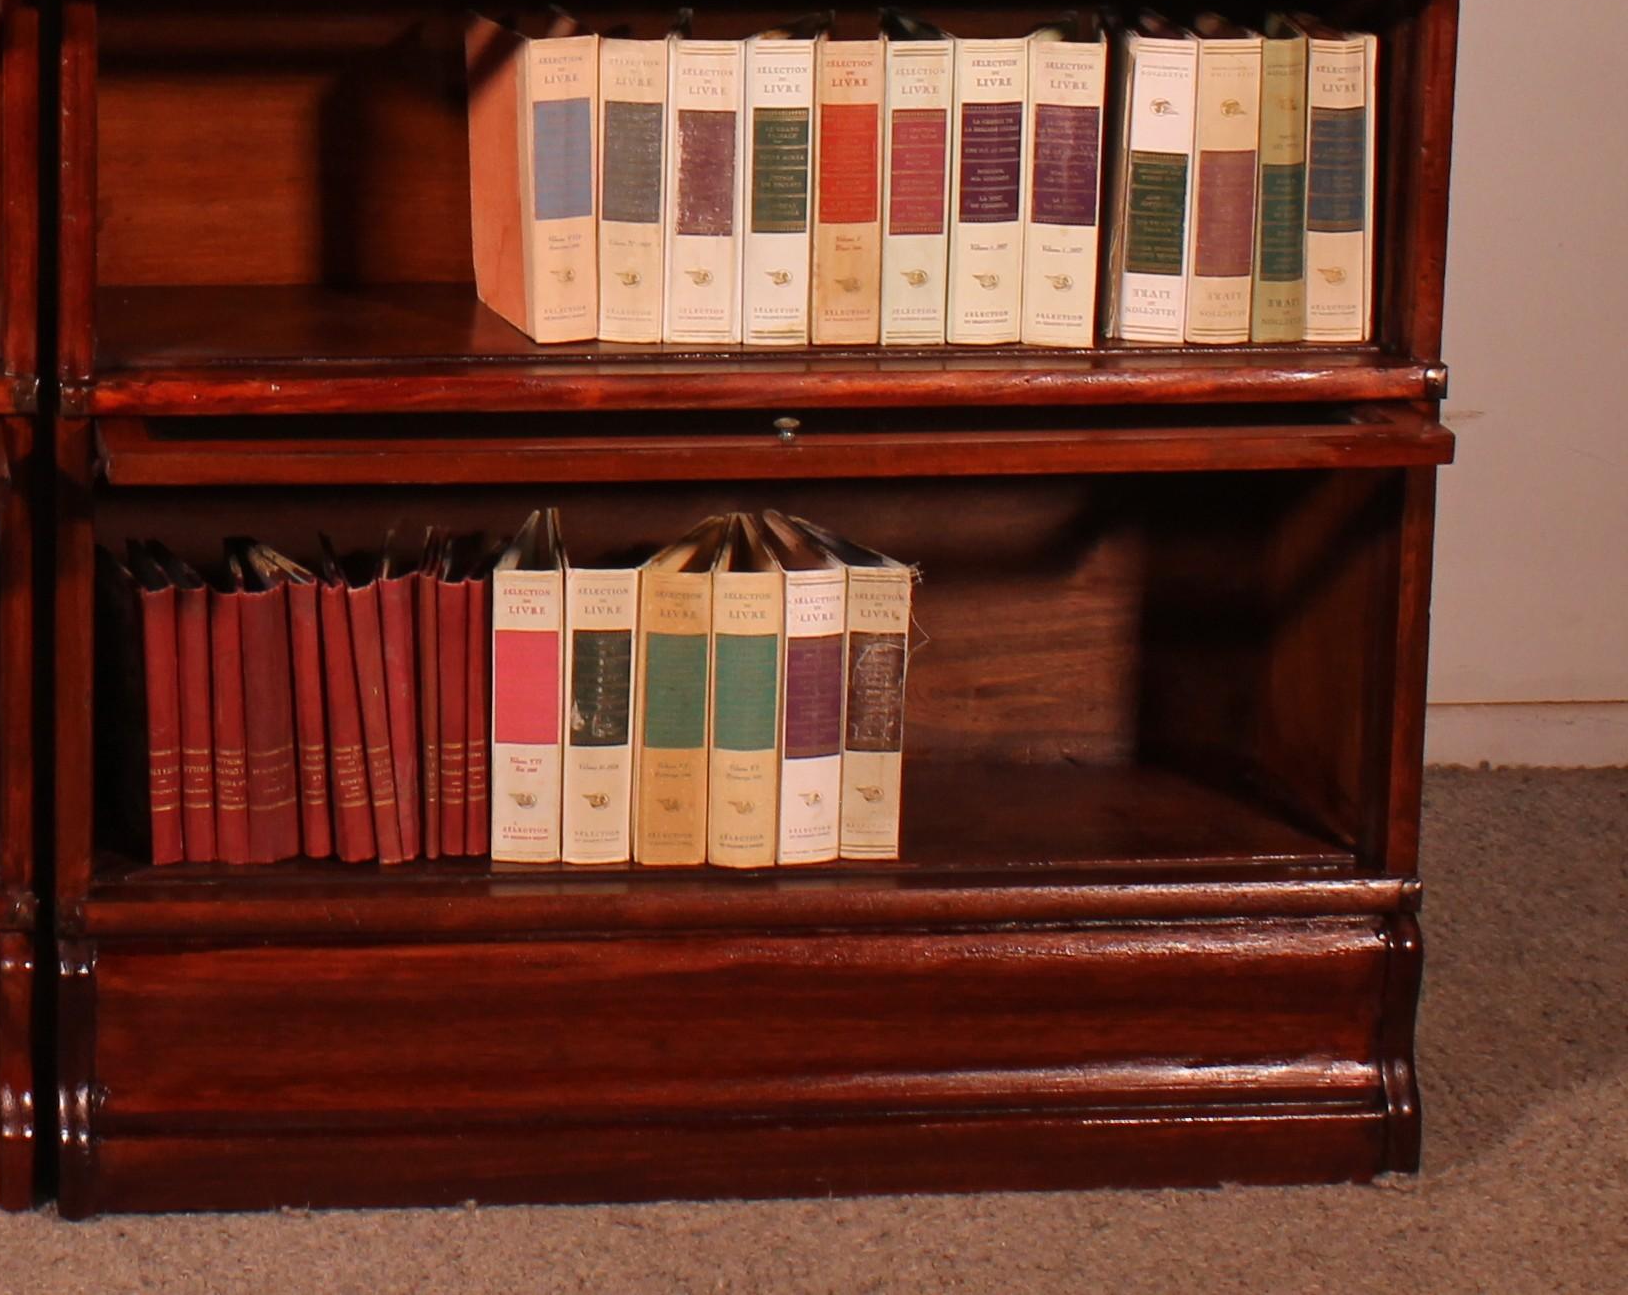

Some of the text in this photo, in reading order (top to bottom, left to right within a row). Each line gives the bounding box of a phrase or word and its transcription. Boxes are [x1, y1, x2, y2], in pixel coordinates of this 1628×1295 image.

[831, 77, 870, 88] LIVRE
[976, 77, 1013, 87] LIVRE
[1050, 80, 1089, 91] LIVRE
[688, 86, 727, 96] LIVRE
[763, 84, 803, 94] LIVRE
[900, 85, 940, 96] LIVRE
[508, 605, 547, 616] LIVRE
[584, 605, 623, 615] LIVRE
[728, 610, 767, 620] LIVRE
[799, 612, 836, 623] LIVRE
